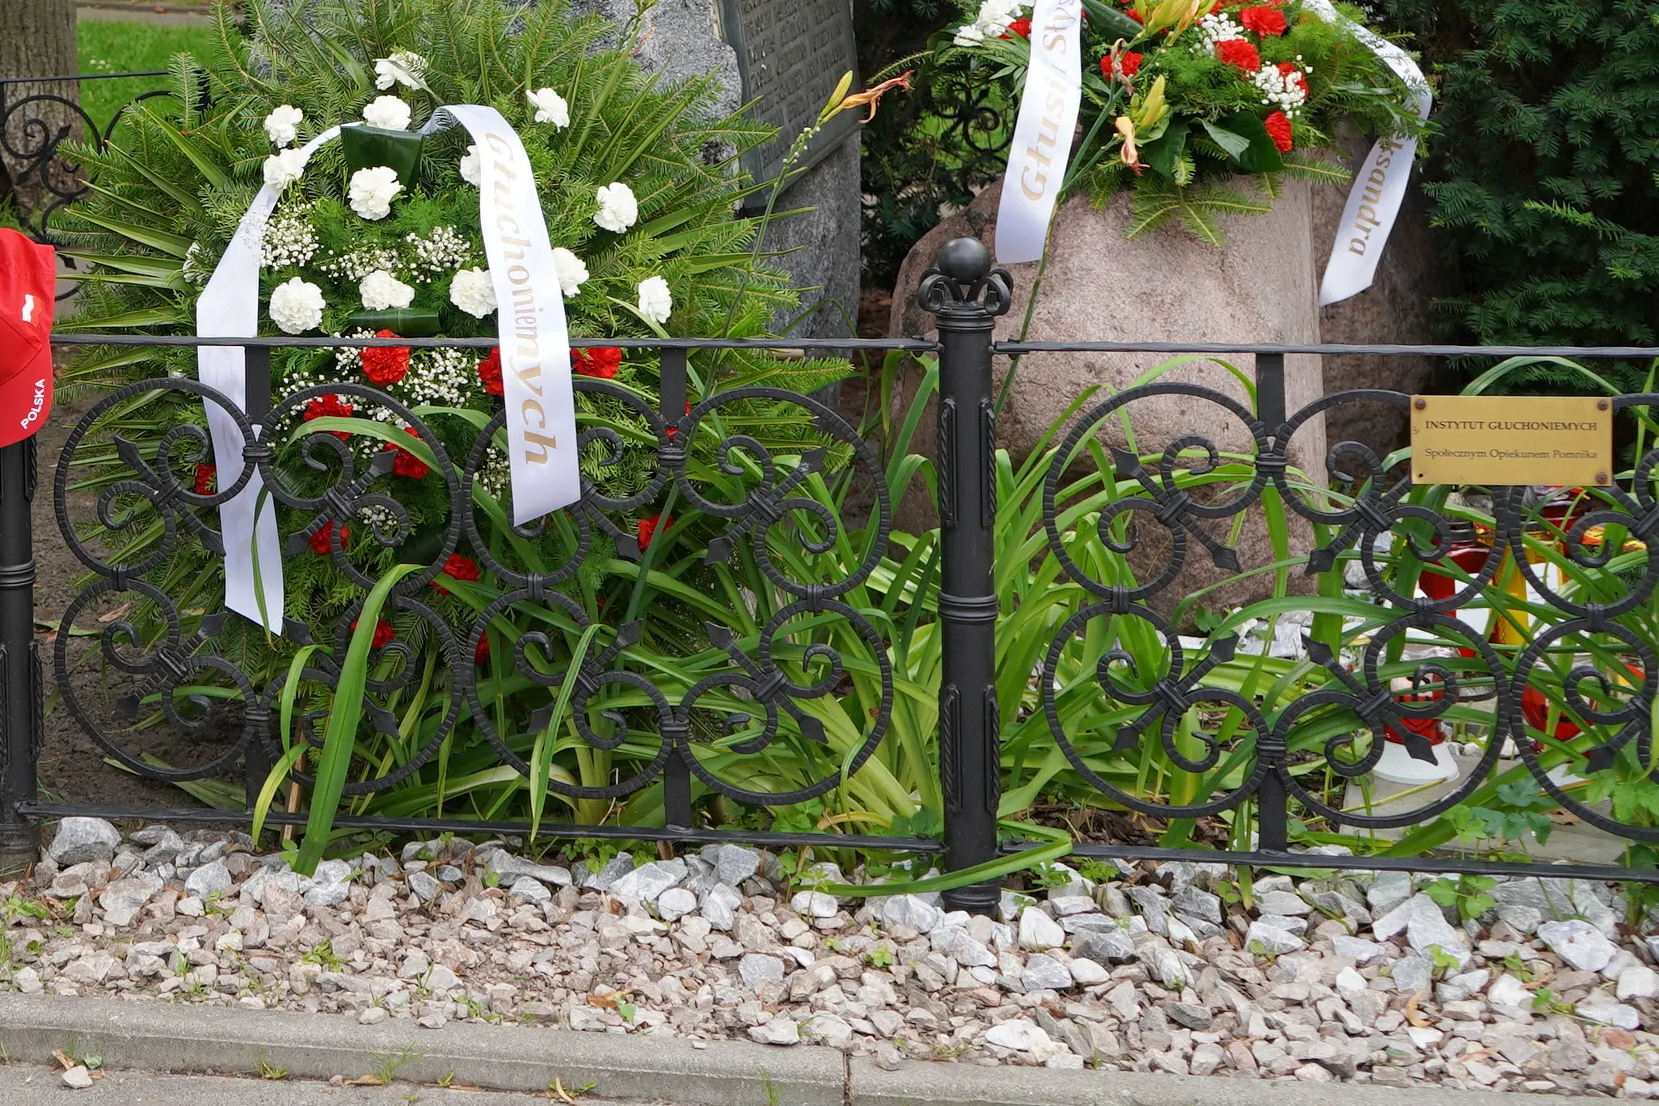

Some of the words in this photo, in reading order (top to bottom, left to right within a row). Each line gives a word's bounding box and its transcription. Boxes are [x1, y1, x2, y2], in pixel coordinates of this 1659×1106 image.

[1020, 77, 1069, 202] Głusi
[484, 130, 559, 466] Głuchoniemych
[20, 378, 46, 430] POLSKA
[1425, 420, 1485, 430] INSTYTUT
[1488, 420, 1598, 431] GŁUCHONIEMYCH
[1424, 448, 1487, 460] Społecznym
[1489, 448, 1550, 460] Opiekunem
[1552, 449, 1598, 459] Pomnika
